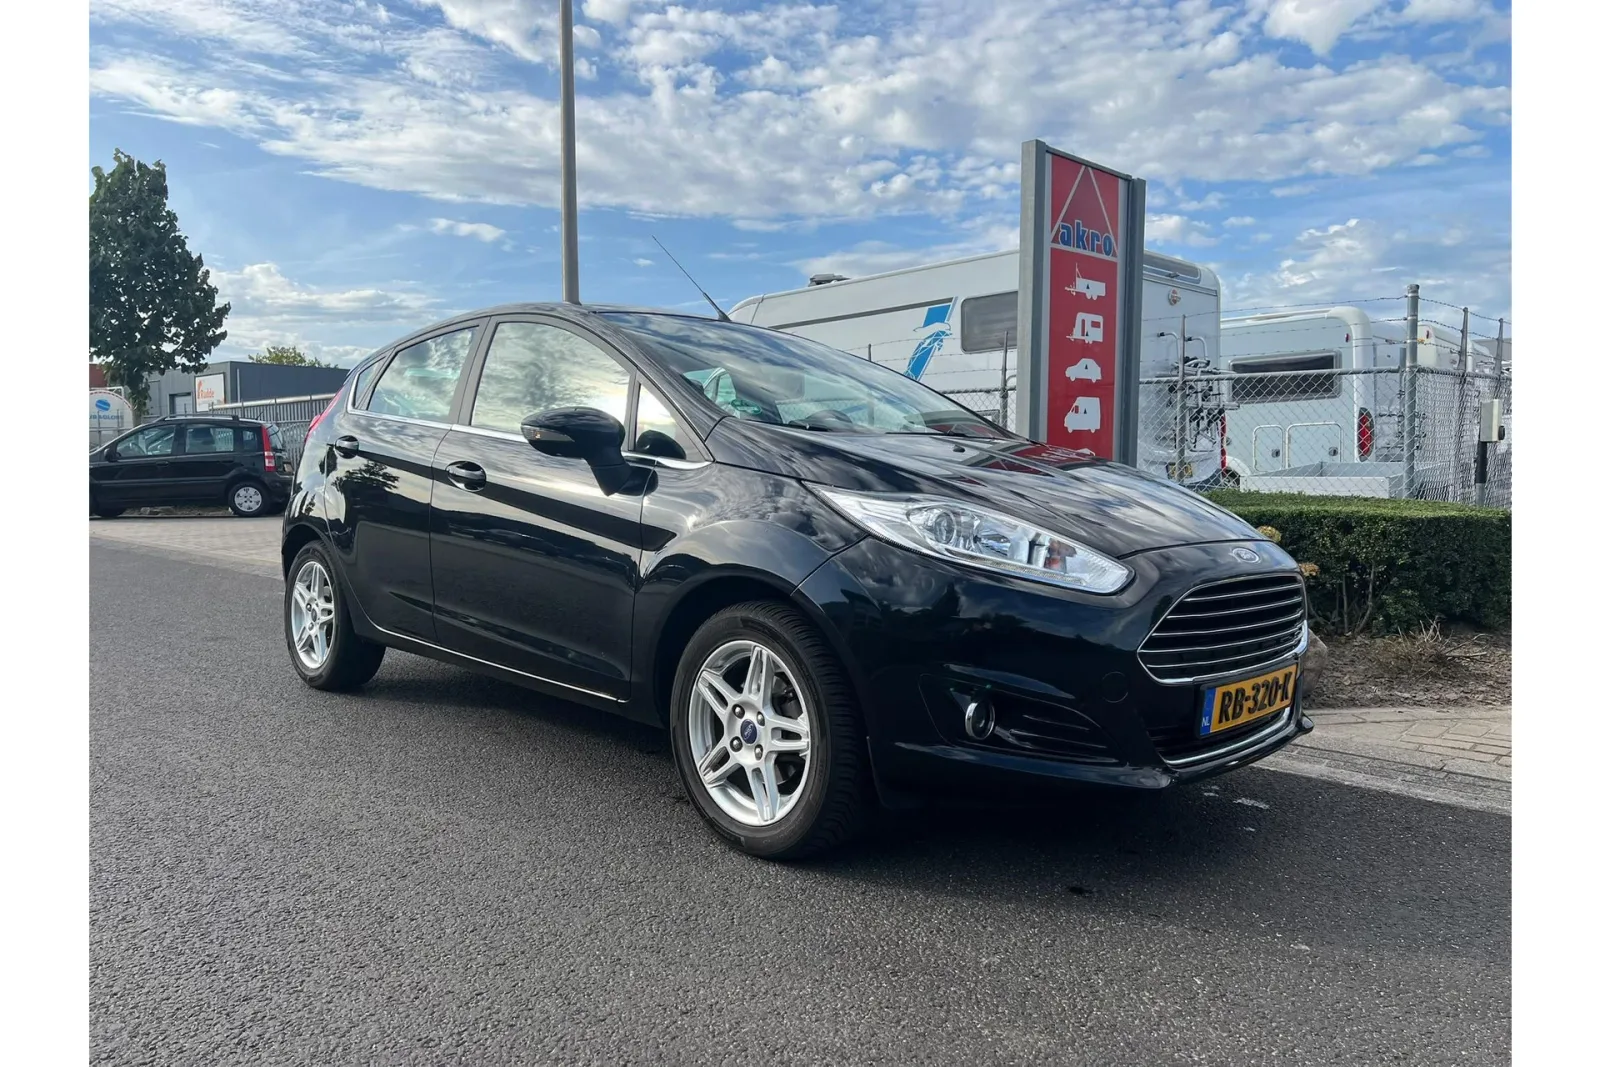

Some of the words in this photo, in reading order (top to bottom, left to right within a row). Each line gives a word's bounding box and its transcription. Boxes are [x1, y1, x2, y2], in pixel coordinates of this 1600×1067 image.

[1059, 219, 1114, 257] akro
[1218, 671, 1293, 724] RB-320-K
[1201, 716, 1210, 727] NL
